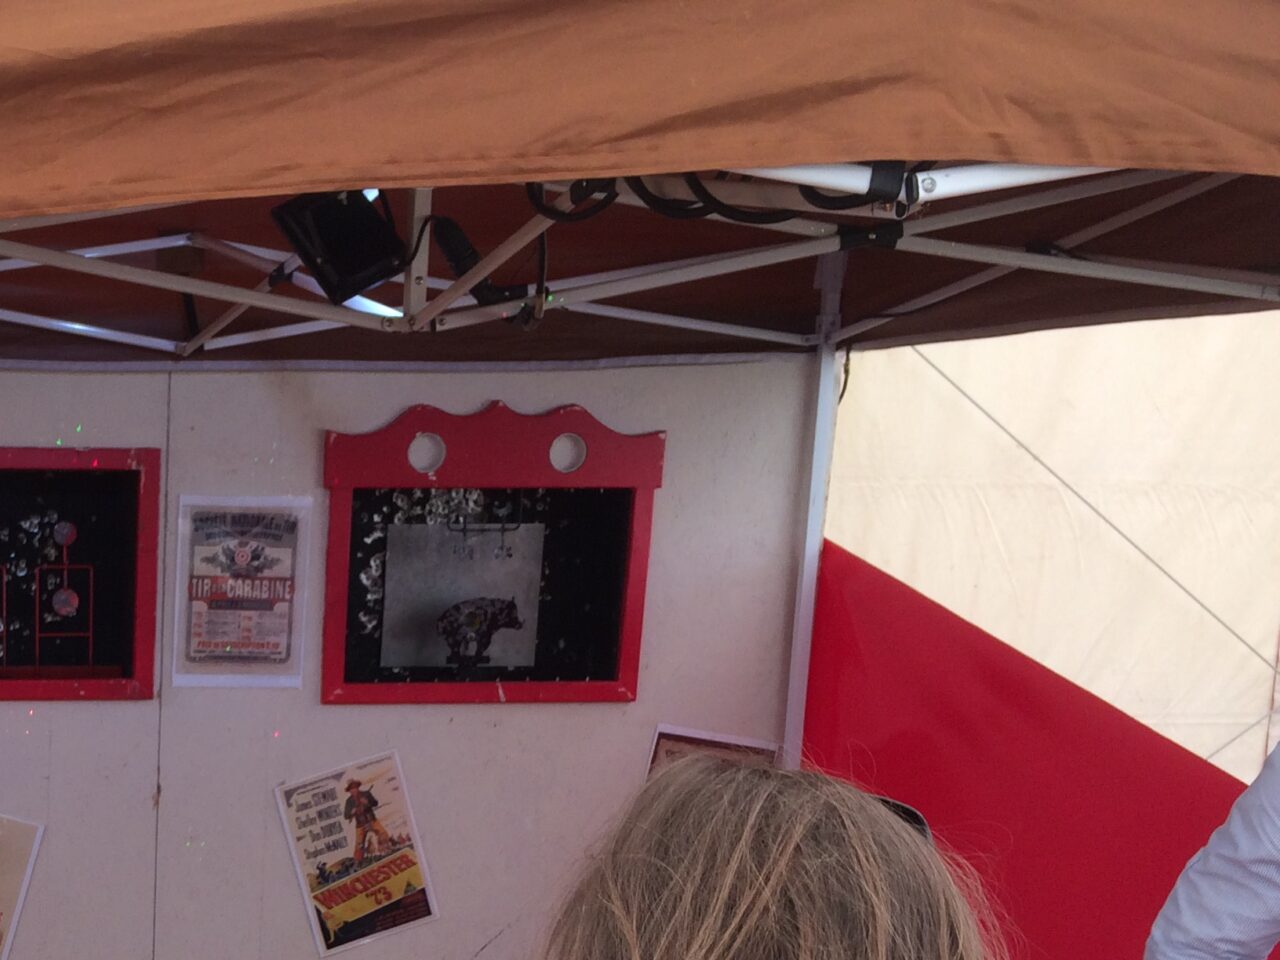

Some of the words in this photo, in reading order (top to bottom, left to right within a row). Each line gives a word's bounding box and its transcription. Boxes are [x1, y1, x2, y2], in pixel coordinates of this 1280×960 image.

[192, 579, 211, 598] TIR
[227, 579, 292, 599] CARABINE
[312, 854, 417, 909] WINCHESTER
